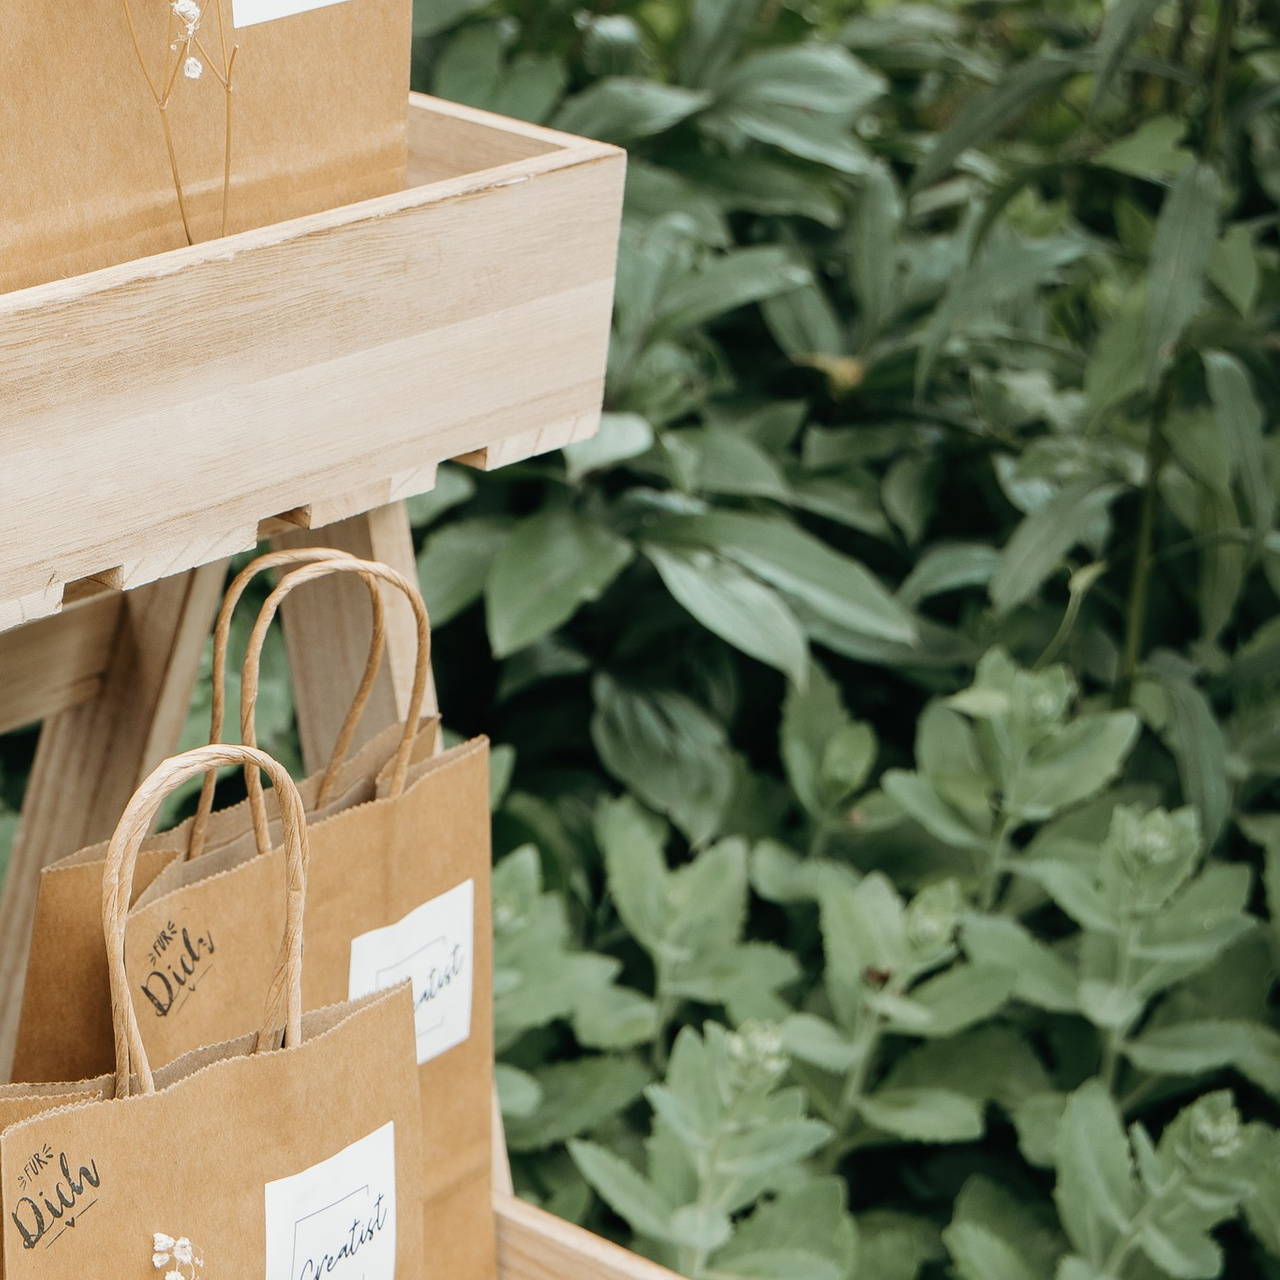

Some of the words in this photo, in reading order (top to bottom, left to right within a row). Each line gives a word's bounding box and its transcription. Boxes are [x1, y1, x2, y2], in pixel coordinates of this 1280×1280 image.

[140, 928, 216, 1017] Dich
[12, 1152, 100, 1250] Dich
[23, 1152, 49, 1182] FÜR
